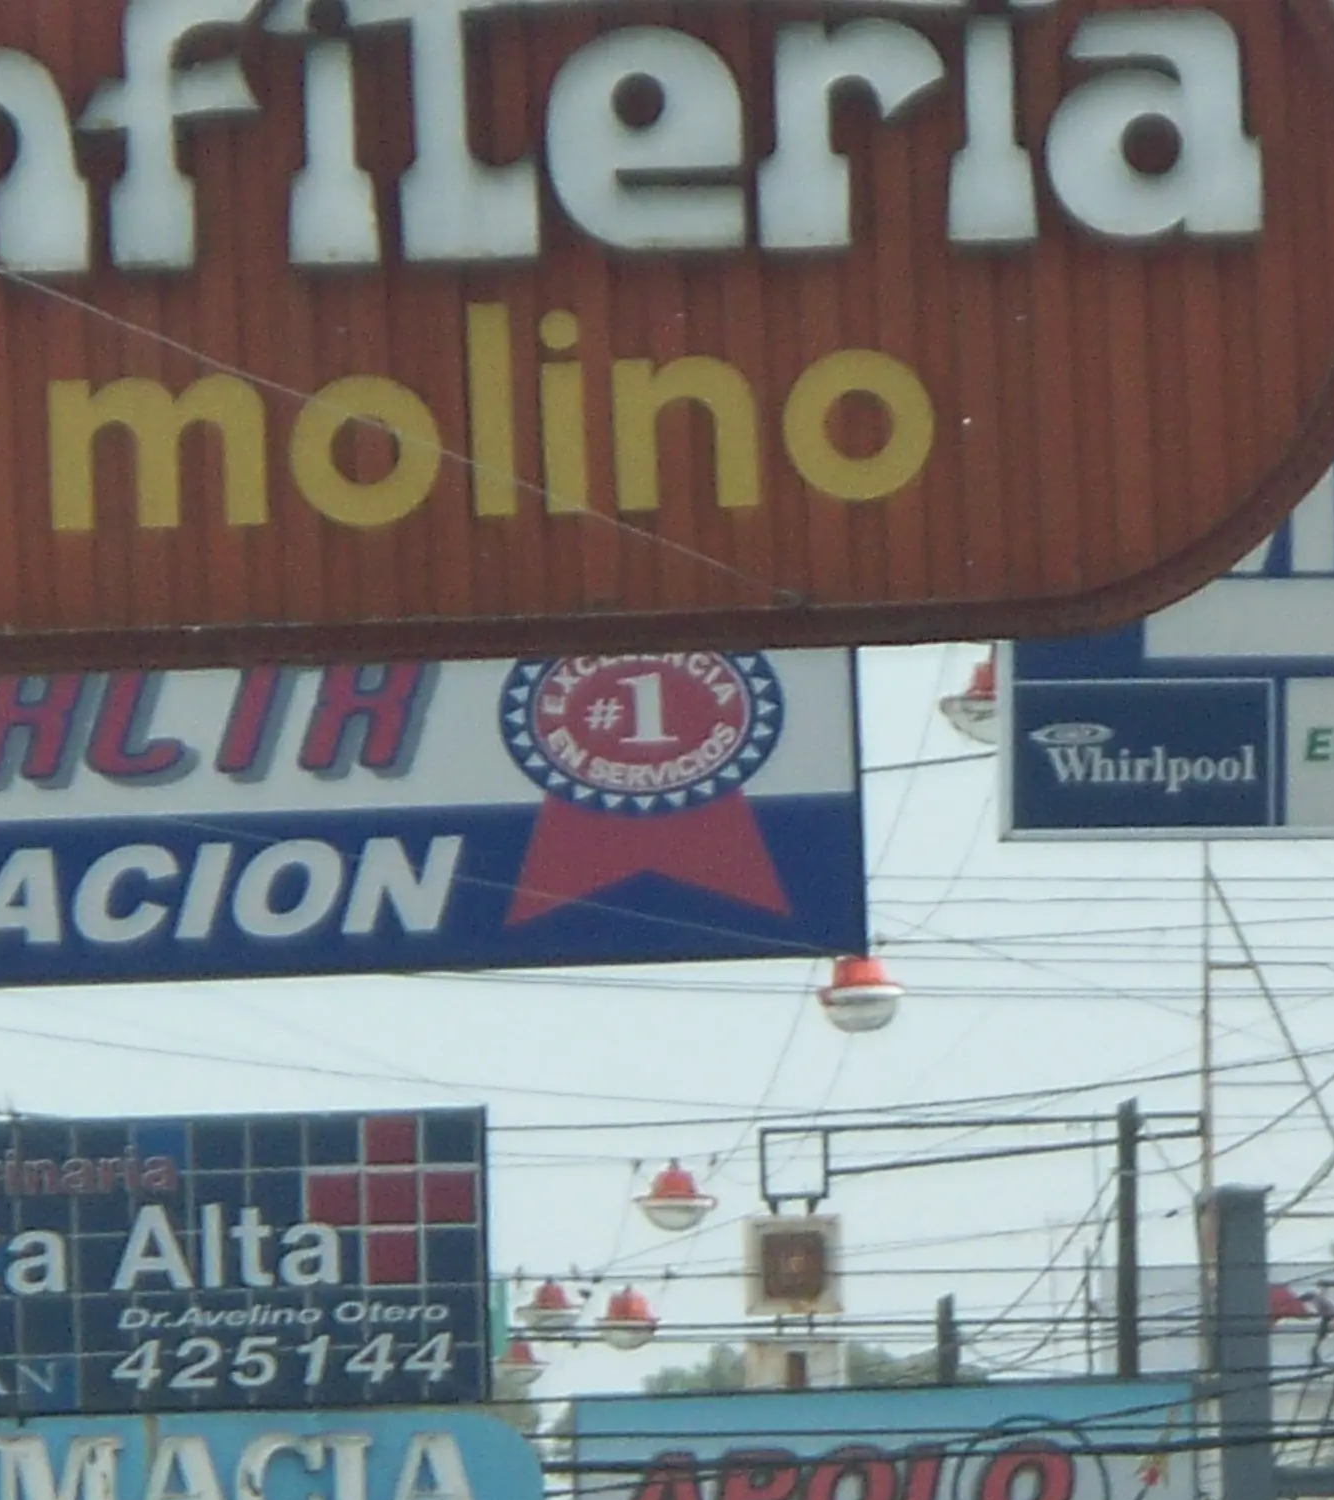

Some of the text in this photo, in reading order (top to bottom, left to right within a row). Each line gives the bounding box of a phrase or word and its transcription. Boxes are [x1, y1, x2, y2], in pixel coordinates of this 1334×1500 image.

[47, 302, 935, 532] molino
[584, 672, 679, 743] #1
[547, 722, 738, 787] EN SERVICIOS
[1045, 744, 1258, 793] Whirlpool
[112, 1202, 343, 1292] Alta
[332, 1301, 451, 1324] Otero
[111, 1332, 453, 1390] 425144
